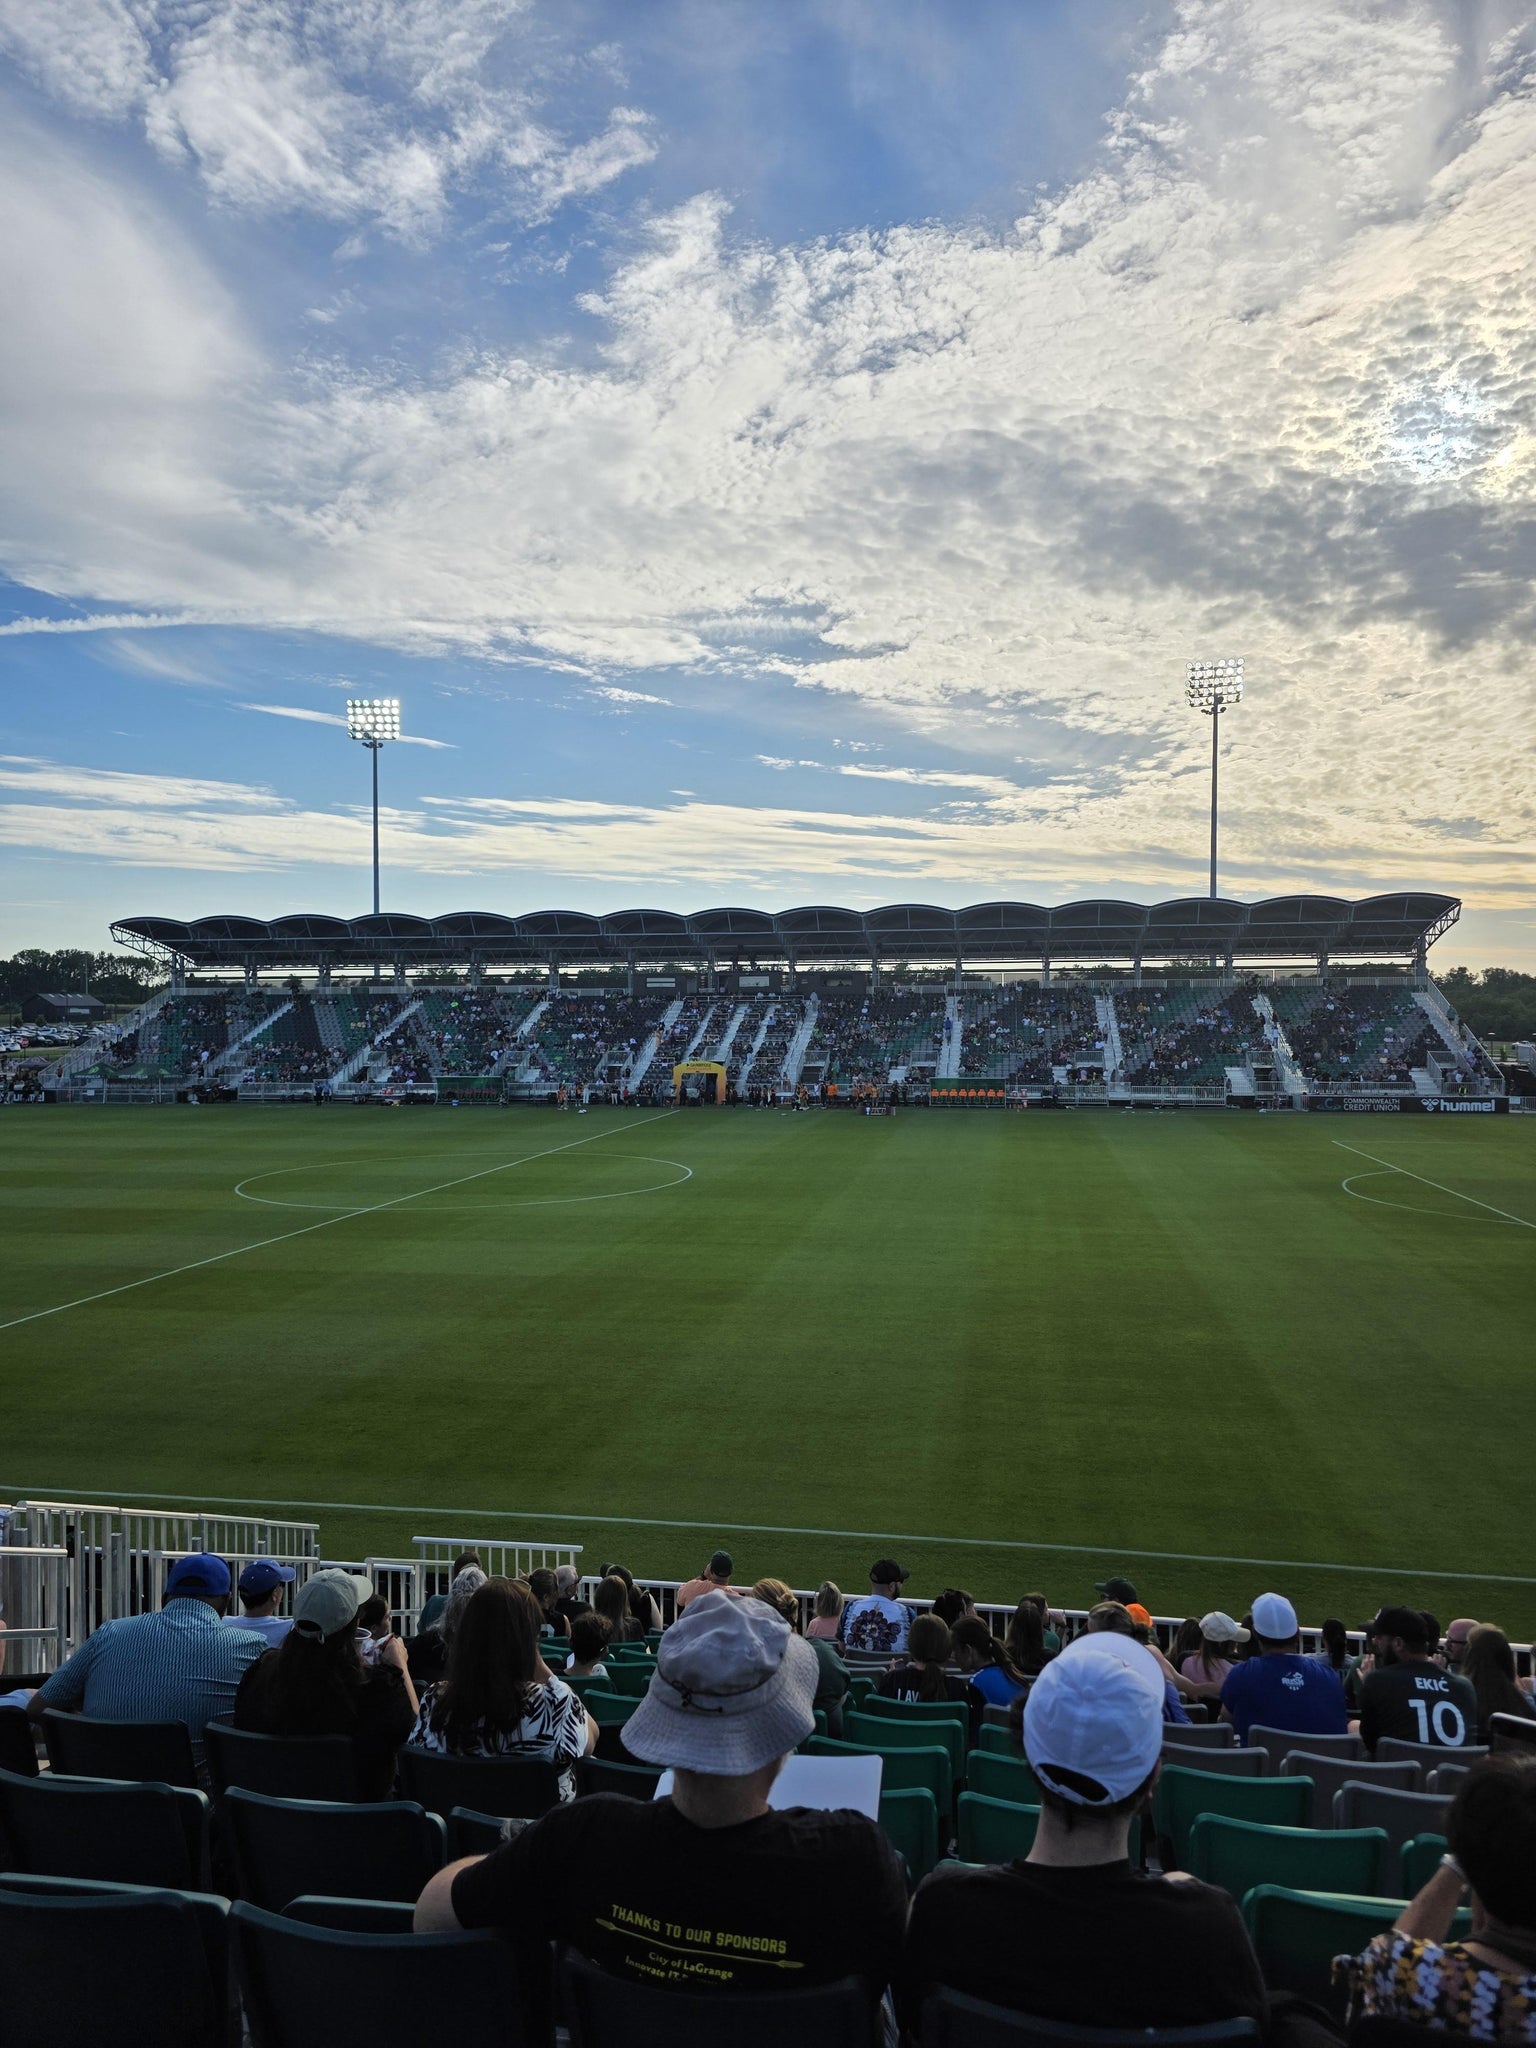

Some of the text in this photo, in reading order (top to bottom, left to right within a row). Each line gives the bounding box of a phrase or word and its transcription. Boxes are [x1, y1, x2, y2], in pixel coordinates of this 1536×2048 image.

[1343, 1103, 1372, 1111] CREDIT
[1440, 1099, 1496, 1112] hummel
[1414, 1676, 1450, 1693] EKIĆ
[1408, 1699, 1466, 1747] 10
[611, 1904, 788, 1955] THANKS TO OUR SPONSORS
[625, 1955, 666, 1978] Innovate
[648, 1951, 734, 1980] City of LaGrange
